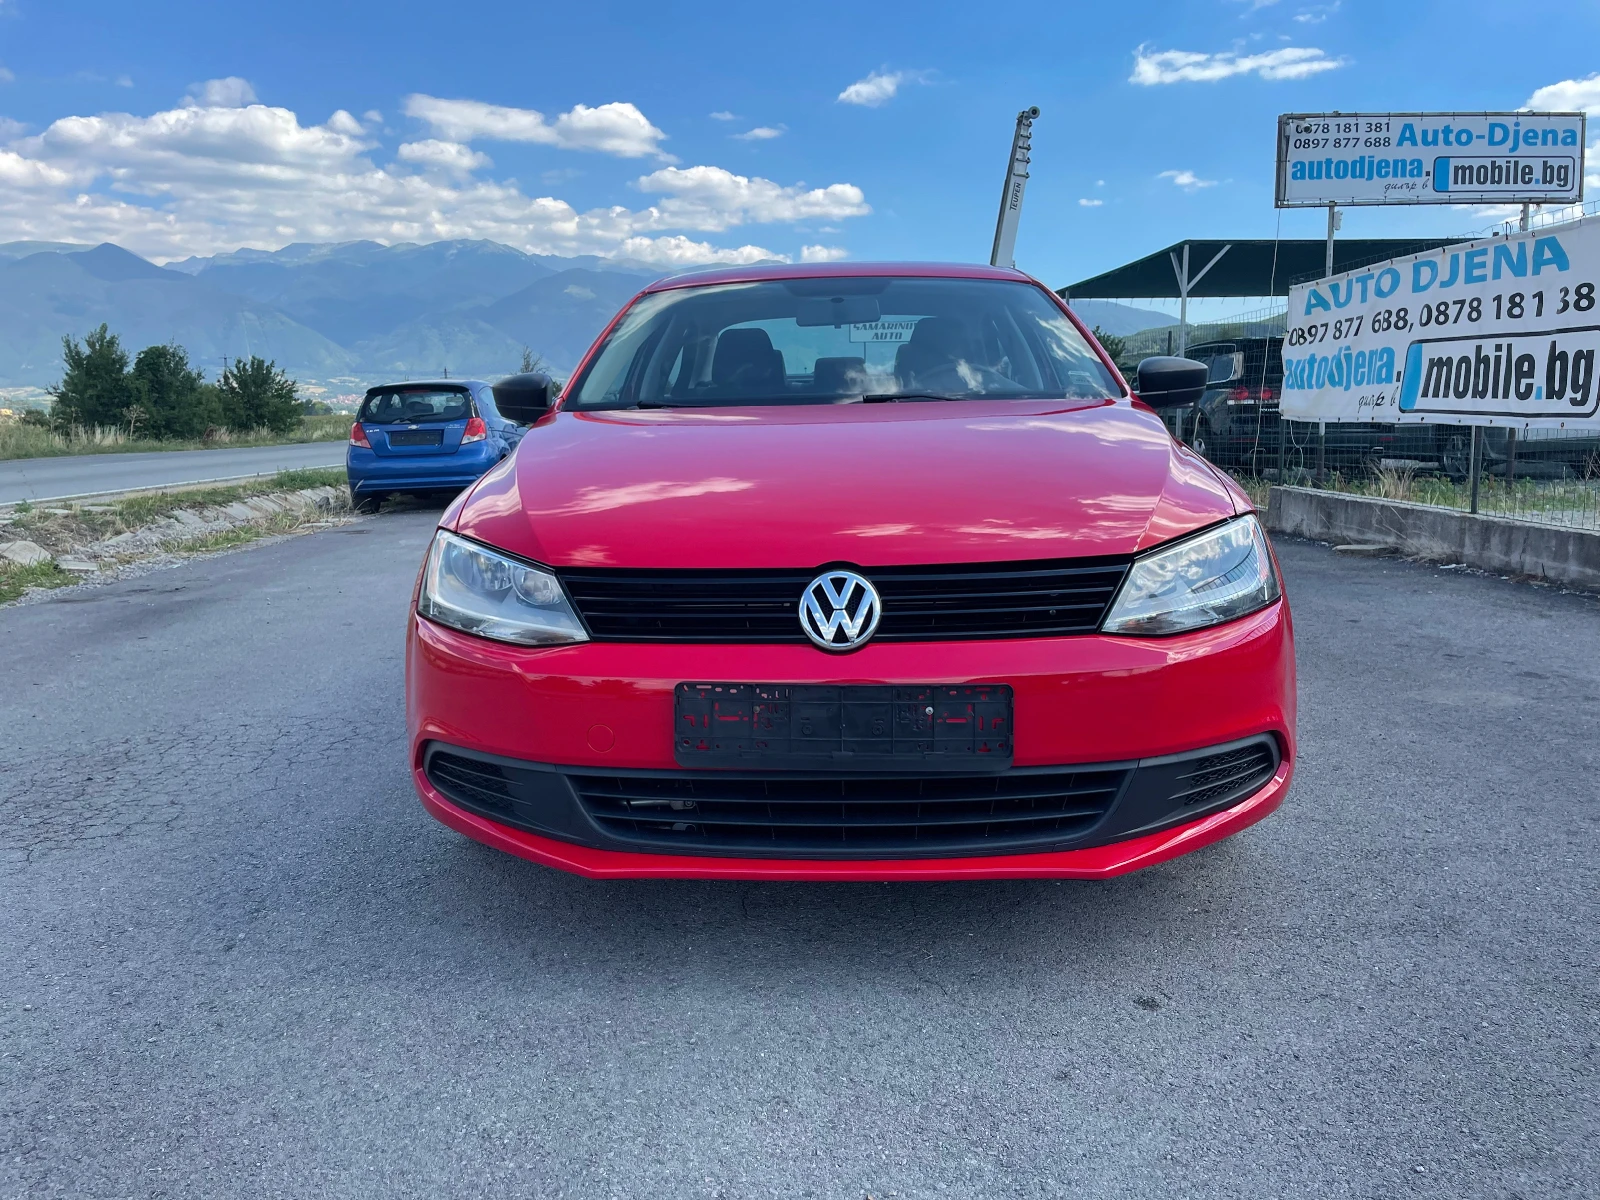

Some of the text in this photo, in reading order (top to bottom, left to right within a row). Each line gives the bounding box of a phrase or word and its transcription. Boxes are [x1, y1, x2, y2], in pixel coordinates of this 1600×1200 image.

[1335, 122, 1359, 134] 181
[1364, 121, 1390, 133] 381
[1396, 121, 1578, 153] Auto-Djena
[1293, 136, 1391, 149] 0897 877 688
[1453, 160, 1570, 188] mobile.bg
[1009, 182, 1022, 211] TEUPEN
[1304, 235, 1570, 316] AUTO DJENA
[853, 322, 917, 331] SAMARINO
[1288, 322, 1329, 347] 0897
[1332, 315, 1364, 340] 877
[1418, 297, 1482, 328] 0878
[1492, 290, 1544, 320] 181
[871, 331, 903, 341] AUTO
[1421, 340, 1595, 407] mobile.bg
